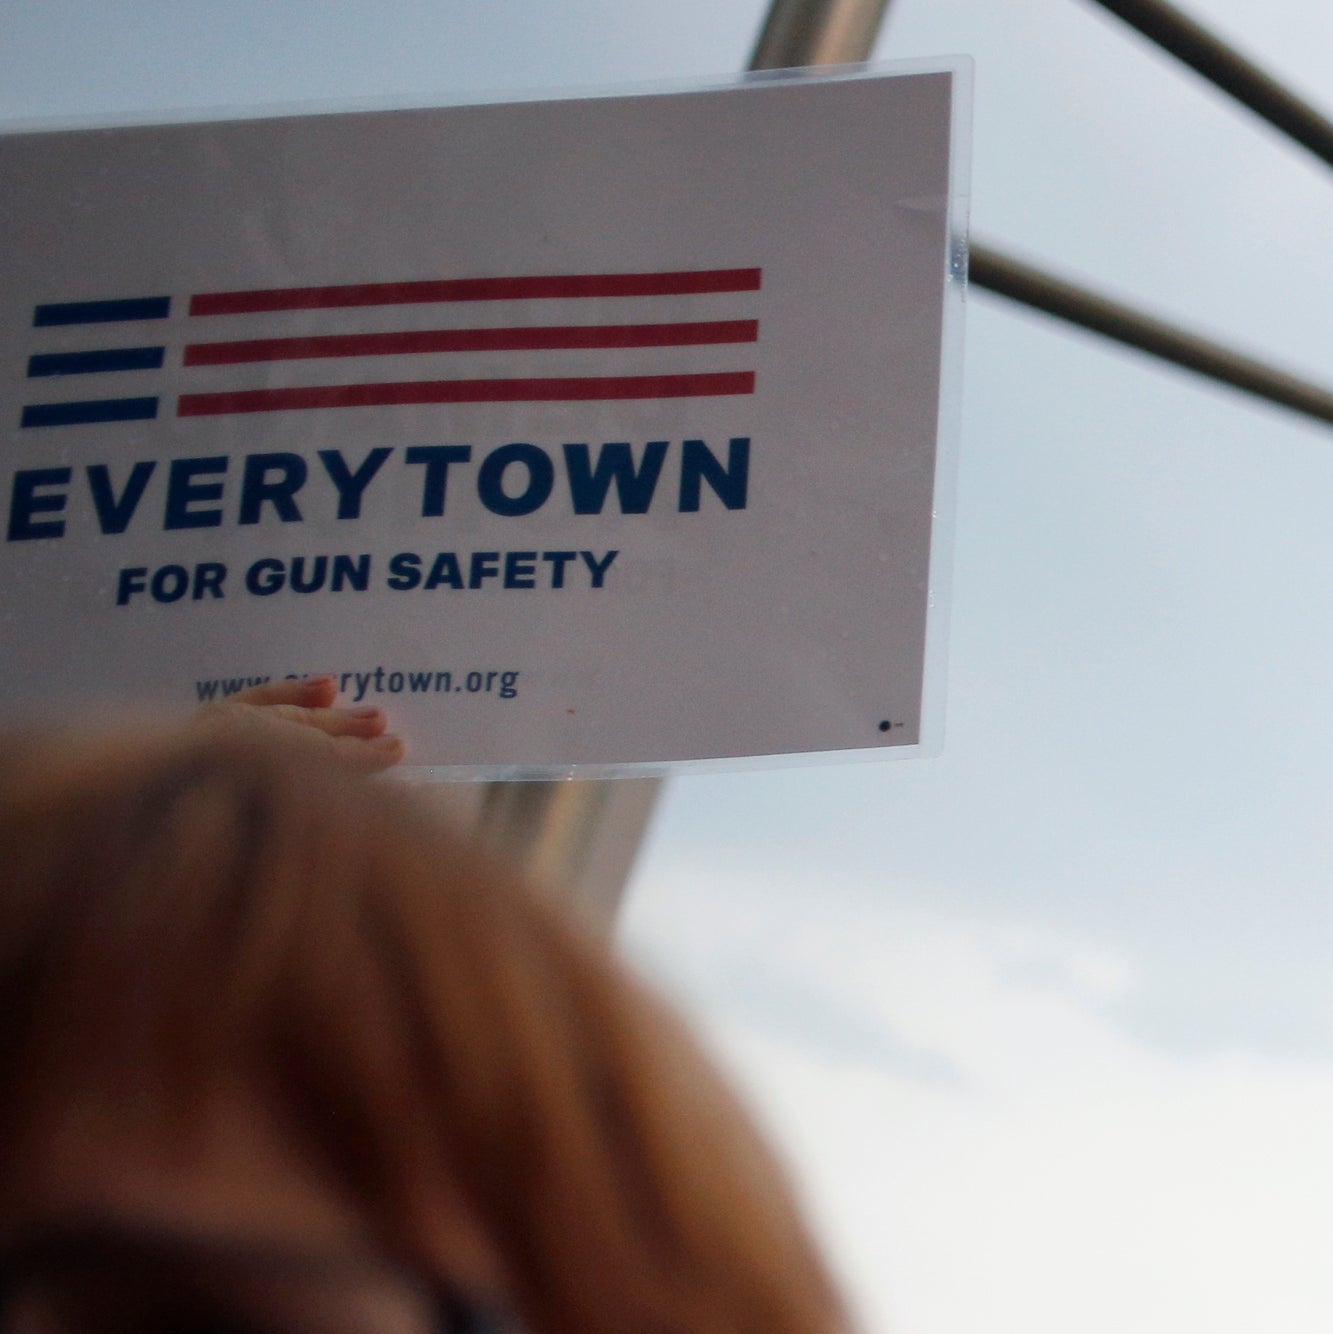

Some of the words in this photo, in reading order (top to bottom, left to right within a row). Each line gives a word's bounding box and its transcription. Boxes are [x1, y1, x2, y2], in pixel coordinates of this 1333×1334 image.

[6, 437, 751, 542] EVERYTOWN
[116, 562, 227, 606] FOR
[245, 554, 371, 596] GUN
[386, 550, 620, 591] SAFETY
[196, 666, 519, 702] wwrytown.org
